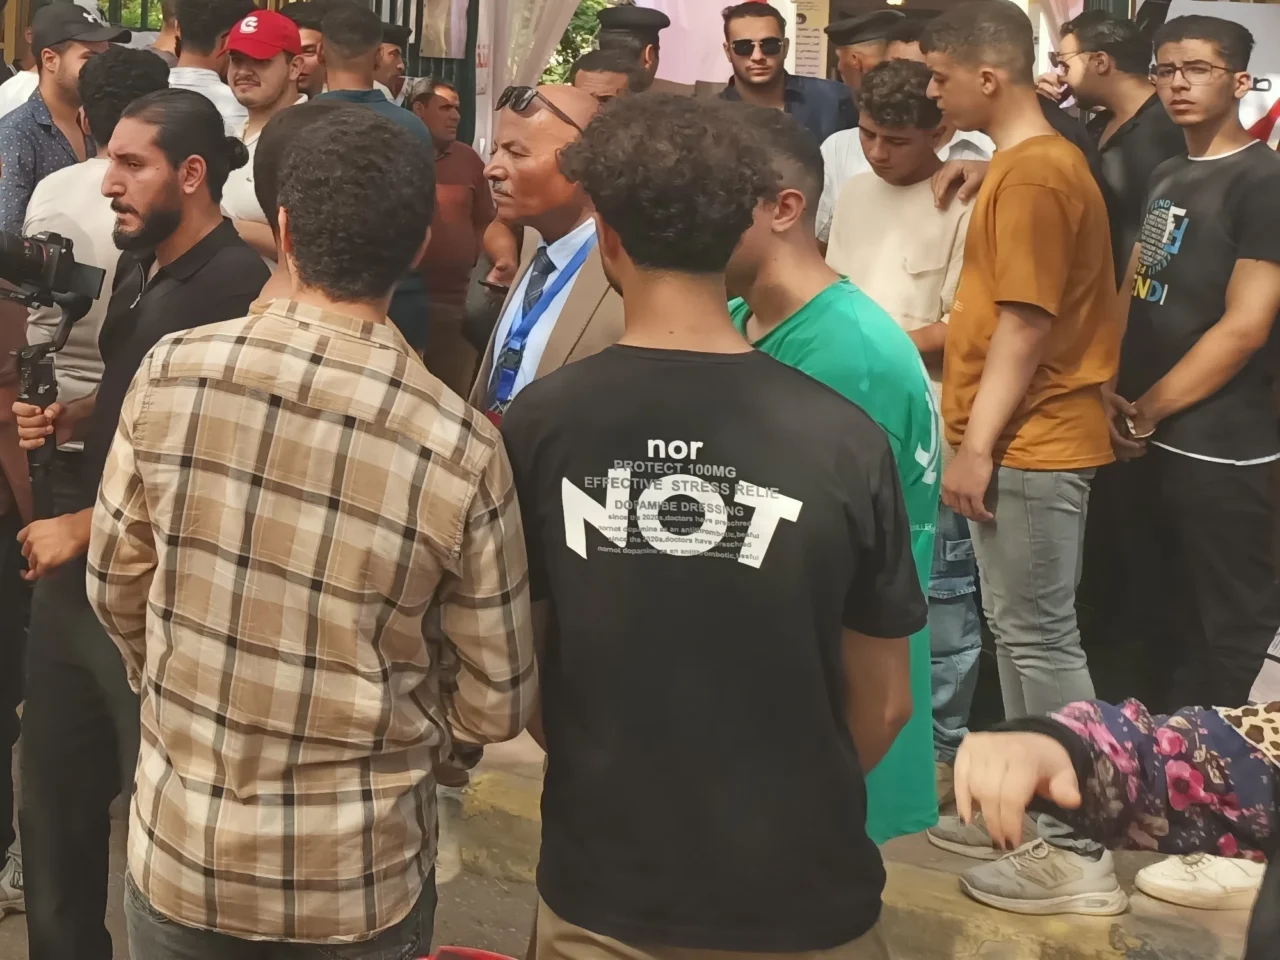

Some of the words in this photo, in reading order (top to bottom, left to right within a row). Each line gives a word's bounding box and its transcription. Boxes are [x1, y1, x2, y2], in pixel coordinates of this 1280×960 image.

[647, 438, 704, 460] nor
[613, 459, 684, 475] PROTECT
[687, 463, 737, 478] 100MG
[583, 476, 663, 491] EFFECTIVE
[671, 480, 730, 495] STRESS
[734, 483, 780, 500] RELIE
[561, 467, 804, 569] NOT
[680, 501, 745, 517] DRESSING
